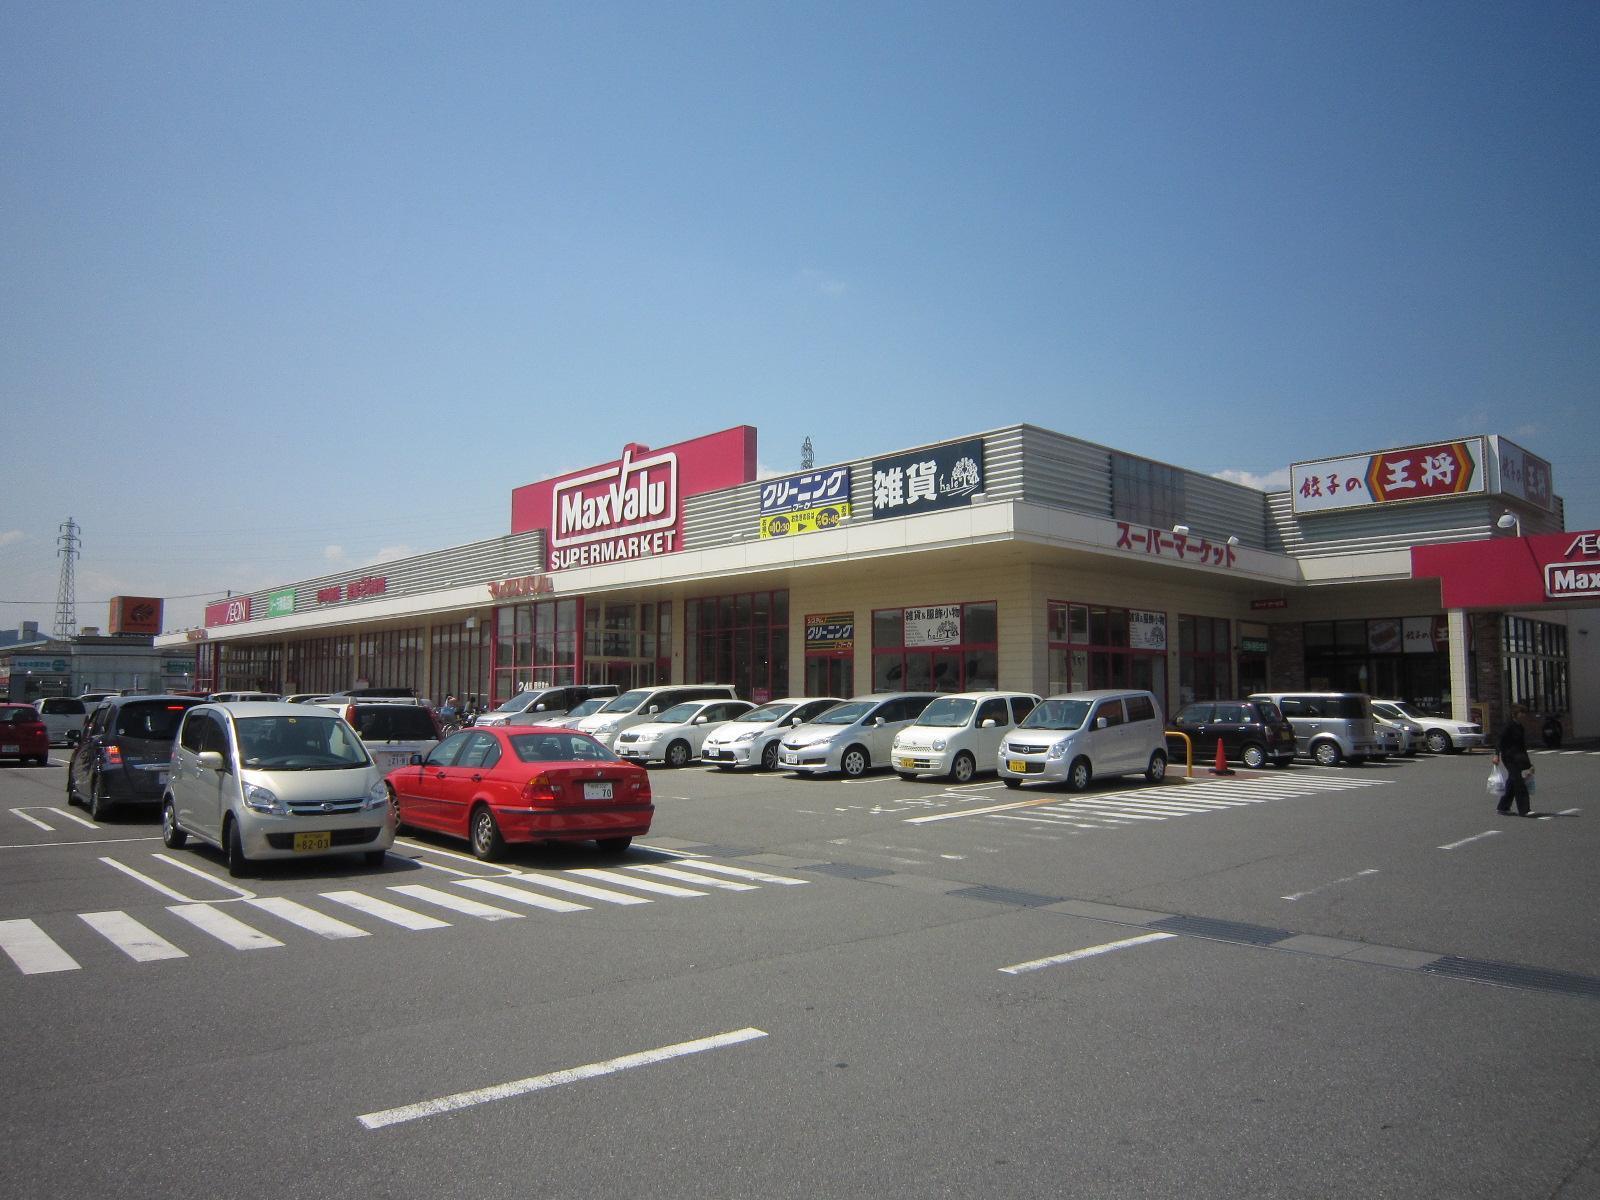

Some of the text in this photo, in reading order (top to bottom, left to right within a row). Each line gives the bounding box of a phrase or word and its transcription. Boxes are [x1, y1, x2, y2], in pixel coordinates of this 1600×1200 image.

[561, 450, 665, 534] MaxValu
[762, 469, 847, 508] クリーニング
[874, 459, 937, 509] 雑貨
[551, 530, 676, 570] SUPERMARKET
[1117, 521, 1236, 568] スーパーマーケット
[807, 625, 854, 640] クリーニング
